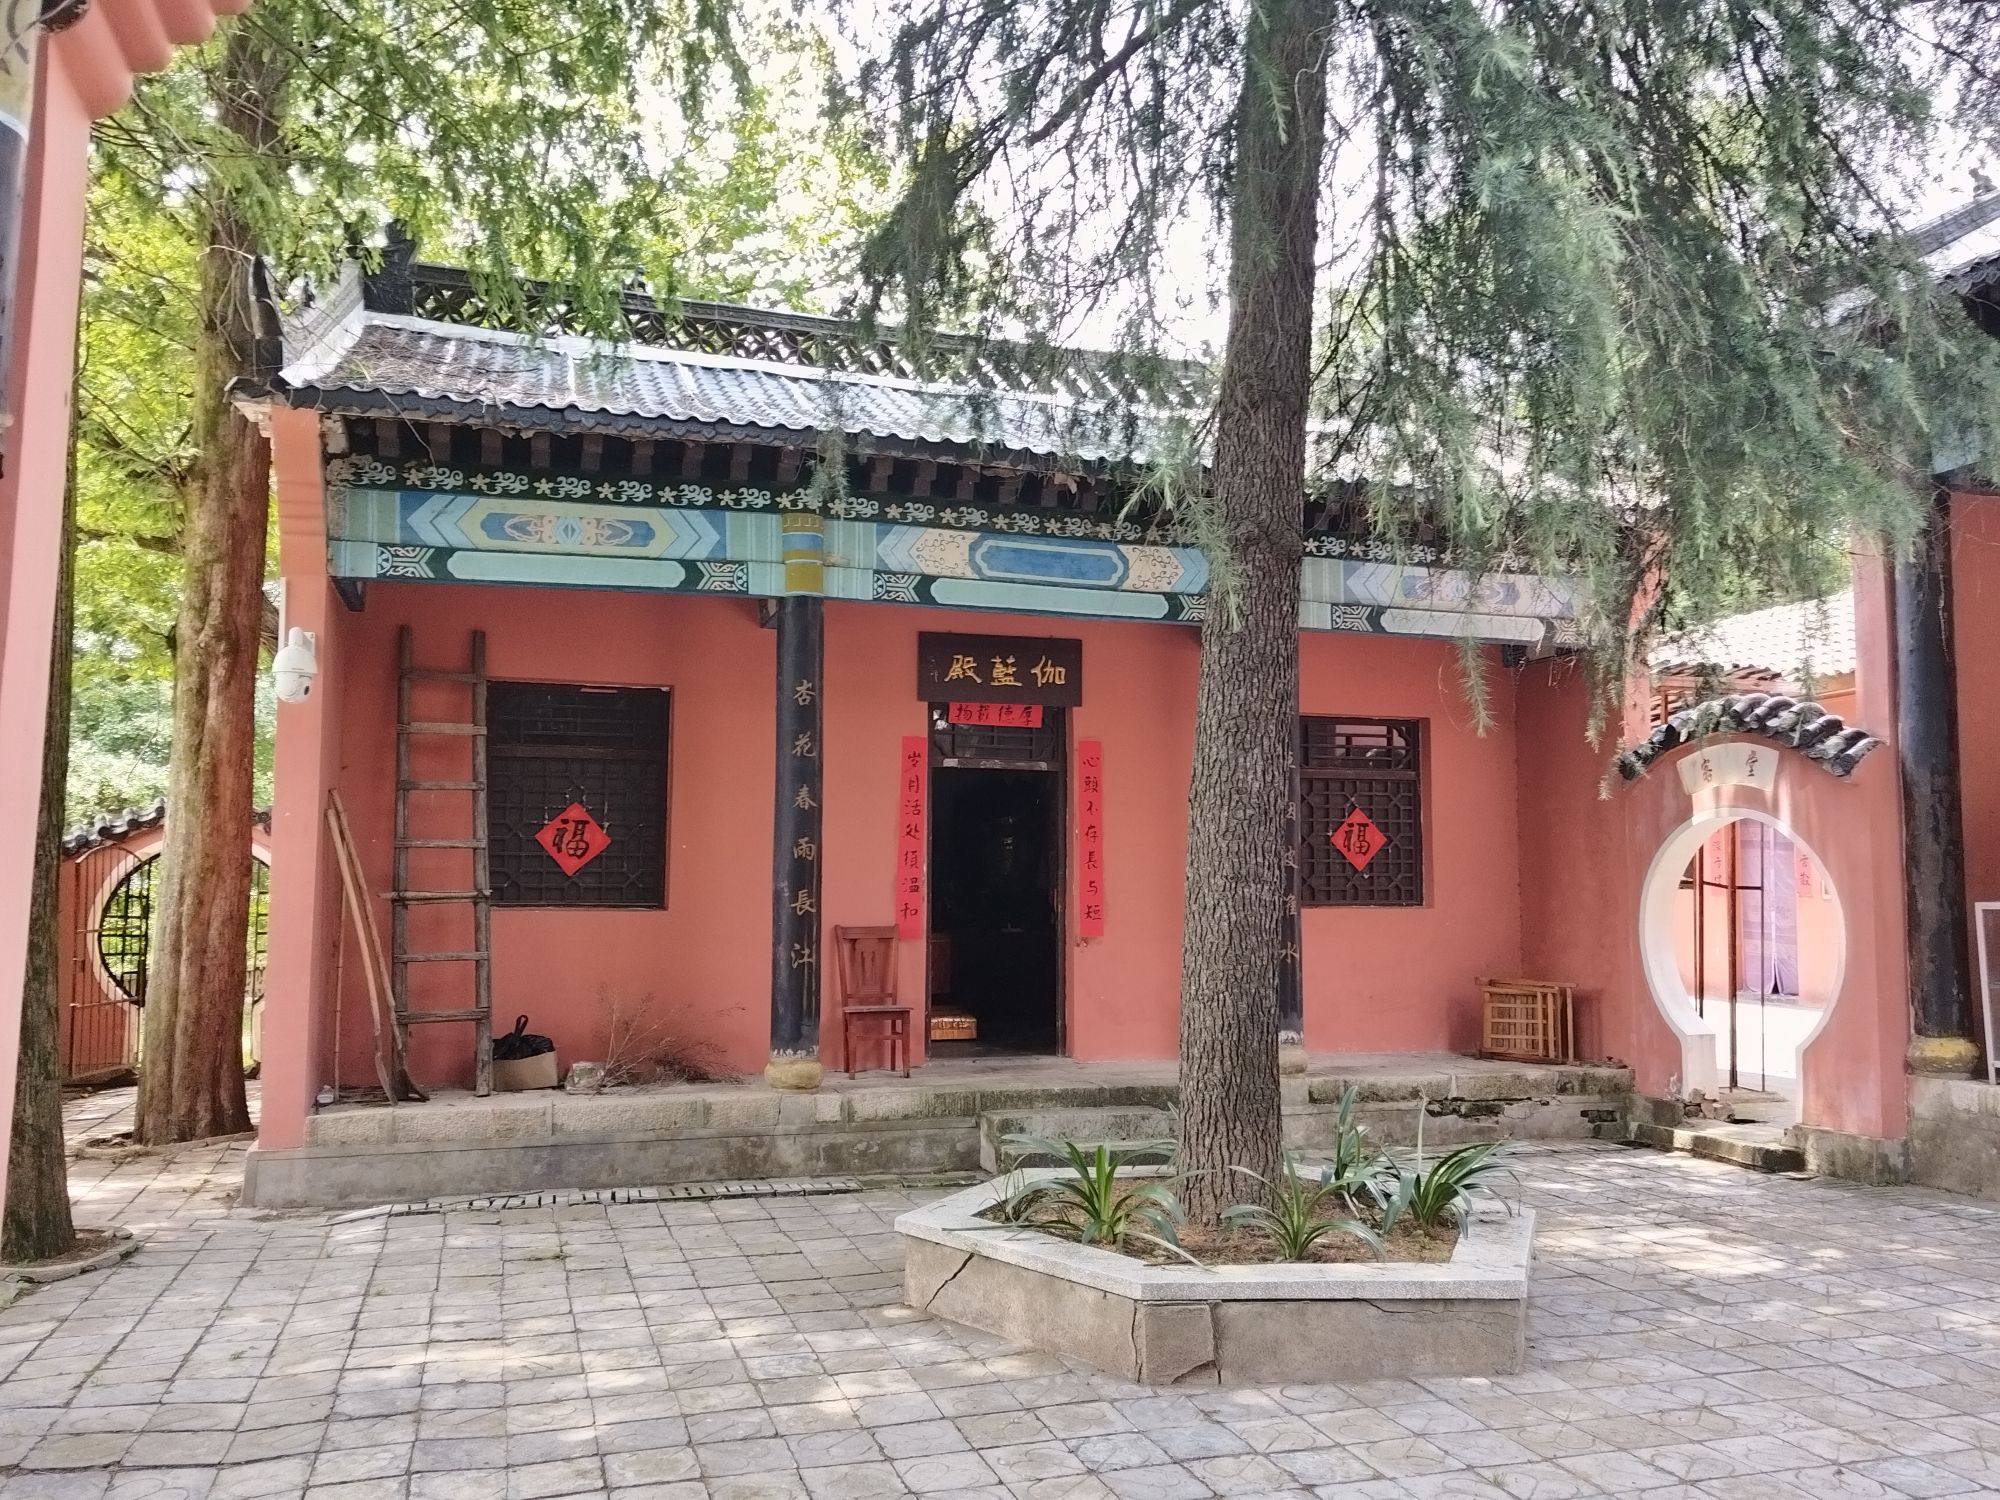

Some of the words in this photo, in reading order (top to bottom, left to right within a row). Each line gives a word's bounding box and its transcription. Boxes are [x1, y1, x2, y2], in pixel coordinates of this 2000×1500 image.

[552, 817, 590, 860] 福
[790, 679, 818, 969] 杏花春雨長江
[1343, 822, 1371, 857] 福
